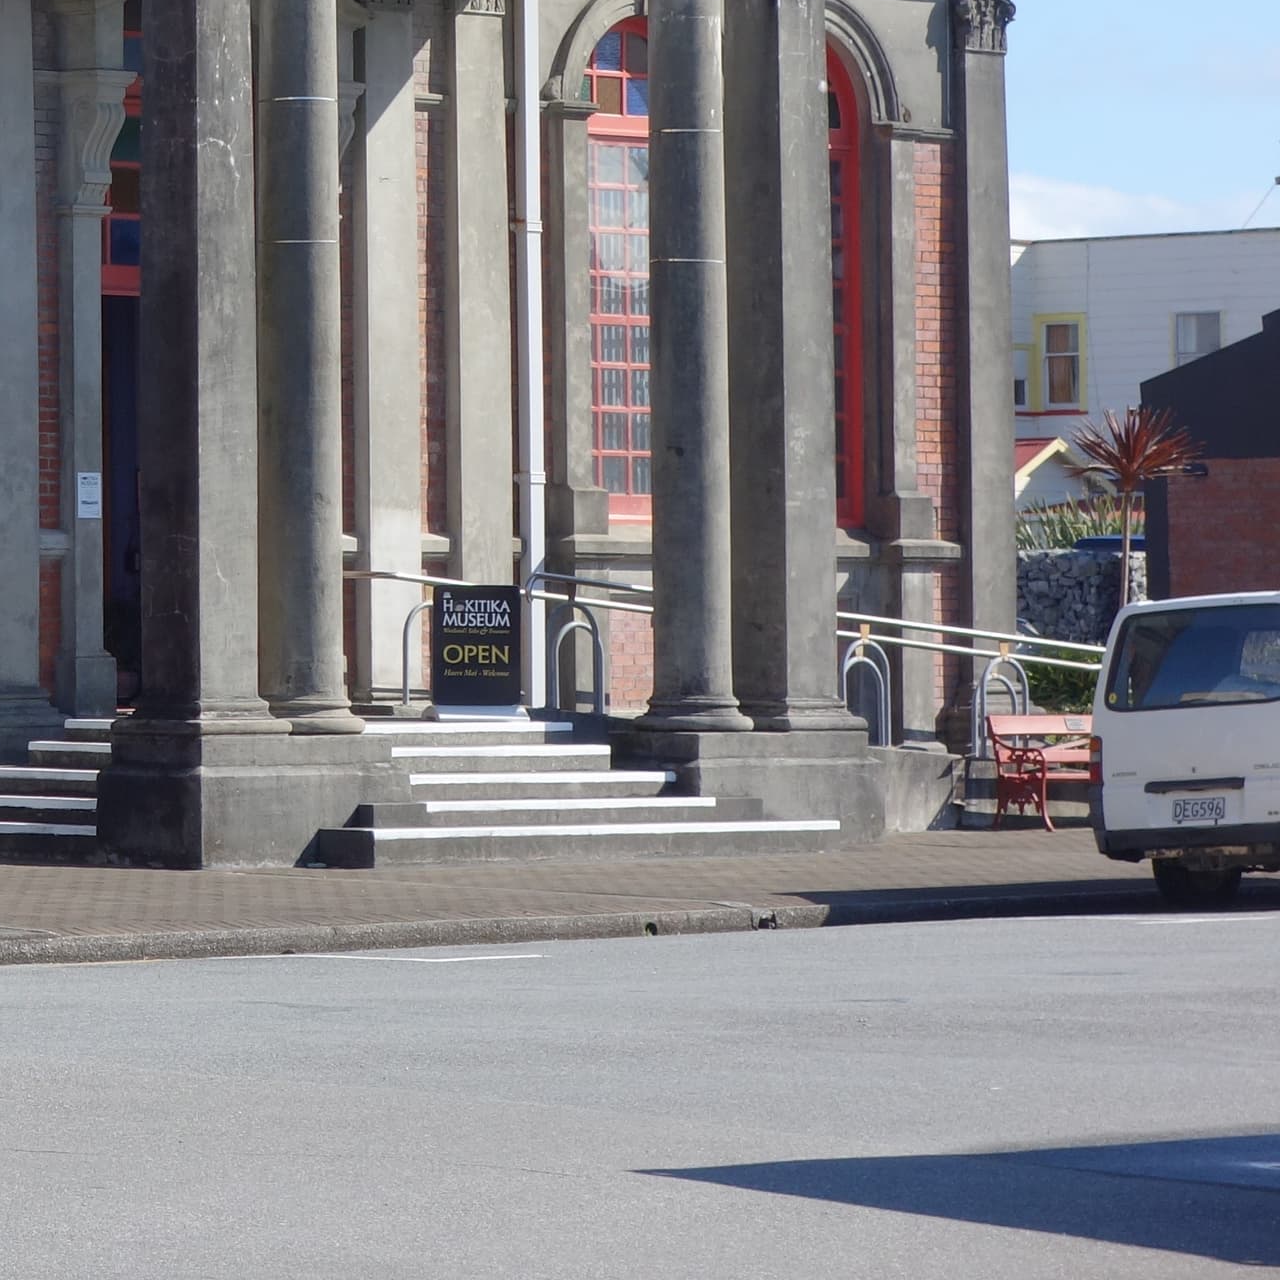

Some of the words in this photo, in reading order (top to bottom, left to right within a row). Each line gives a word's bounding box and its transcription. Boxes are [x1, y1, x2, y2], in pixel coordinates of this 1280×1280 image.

[442, 613, 510, 627] MUSEUM
[443, 644, 510, 664] OPEN
[1174, 800, 1223, 819] DEG596
